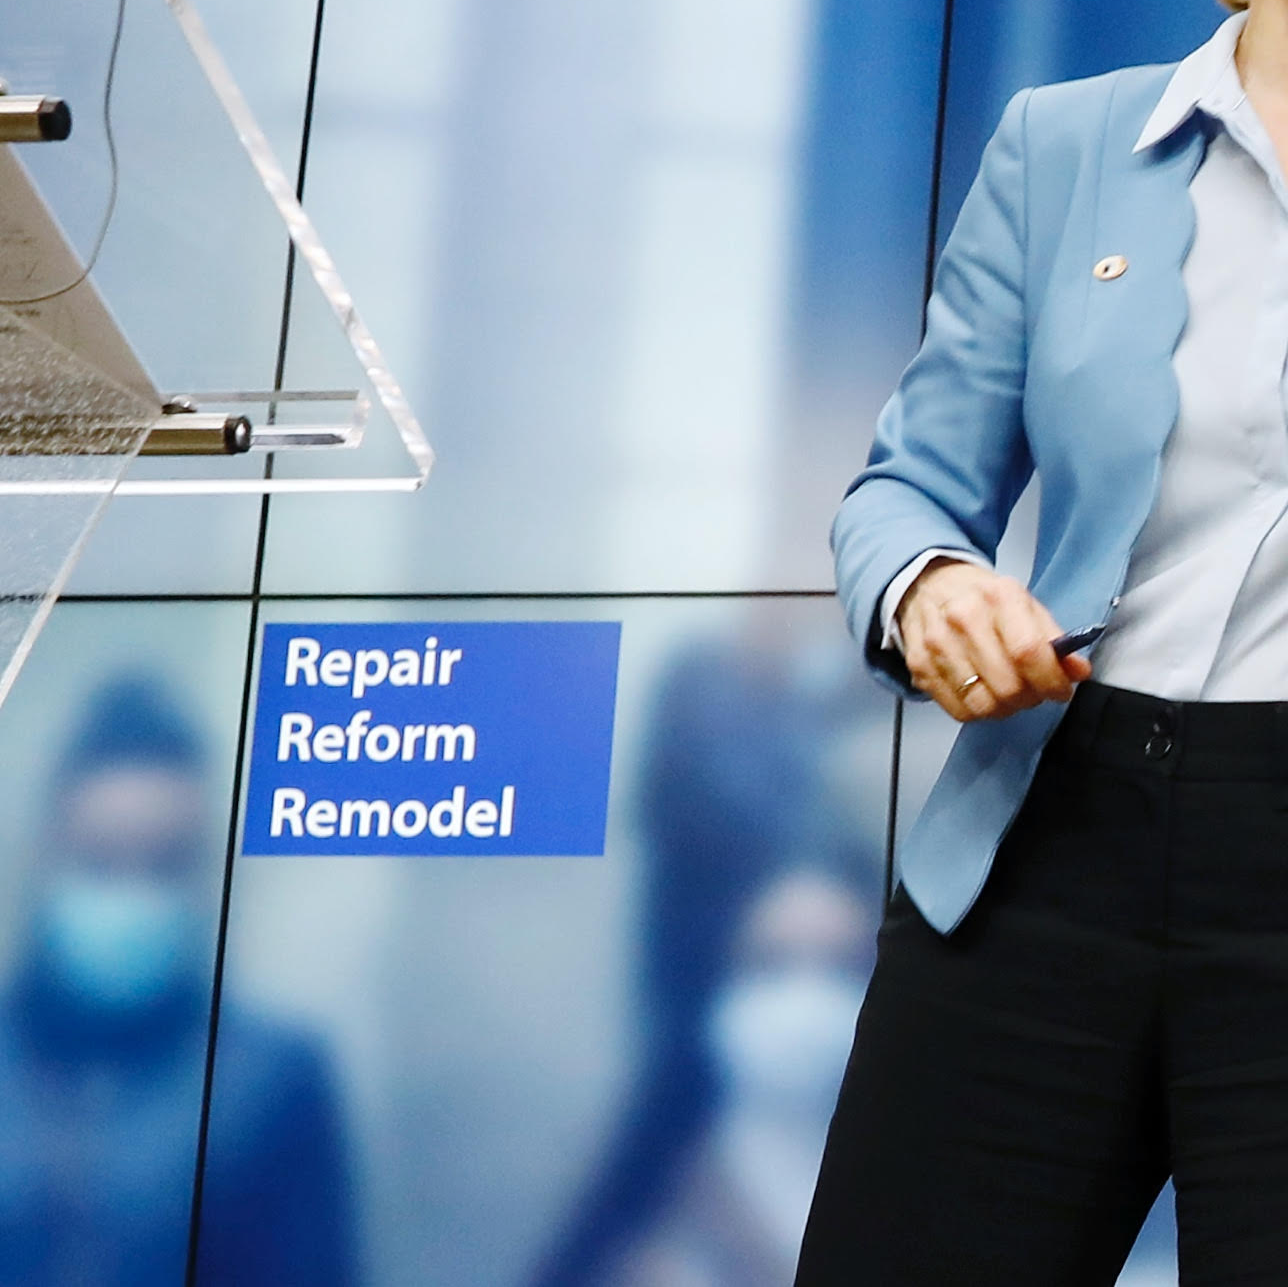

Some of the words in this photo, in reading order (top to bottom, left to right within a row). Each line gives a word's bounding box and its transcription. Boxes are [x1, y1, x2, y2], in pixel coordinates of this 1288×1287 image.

[285, 636, 462, 699] Repair
[277, 711, 477, 763] Reform
[269, 786, 516, 838] Remodel
